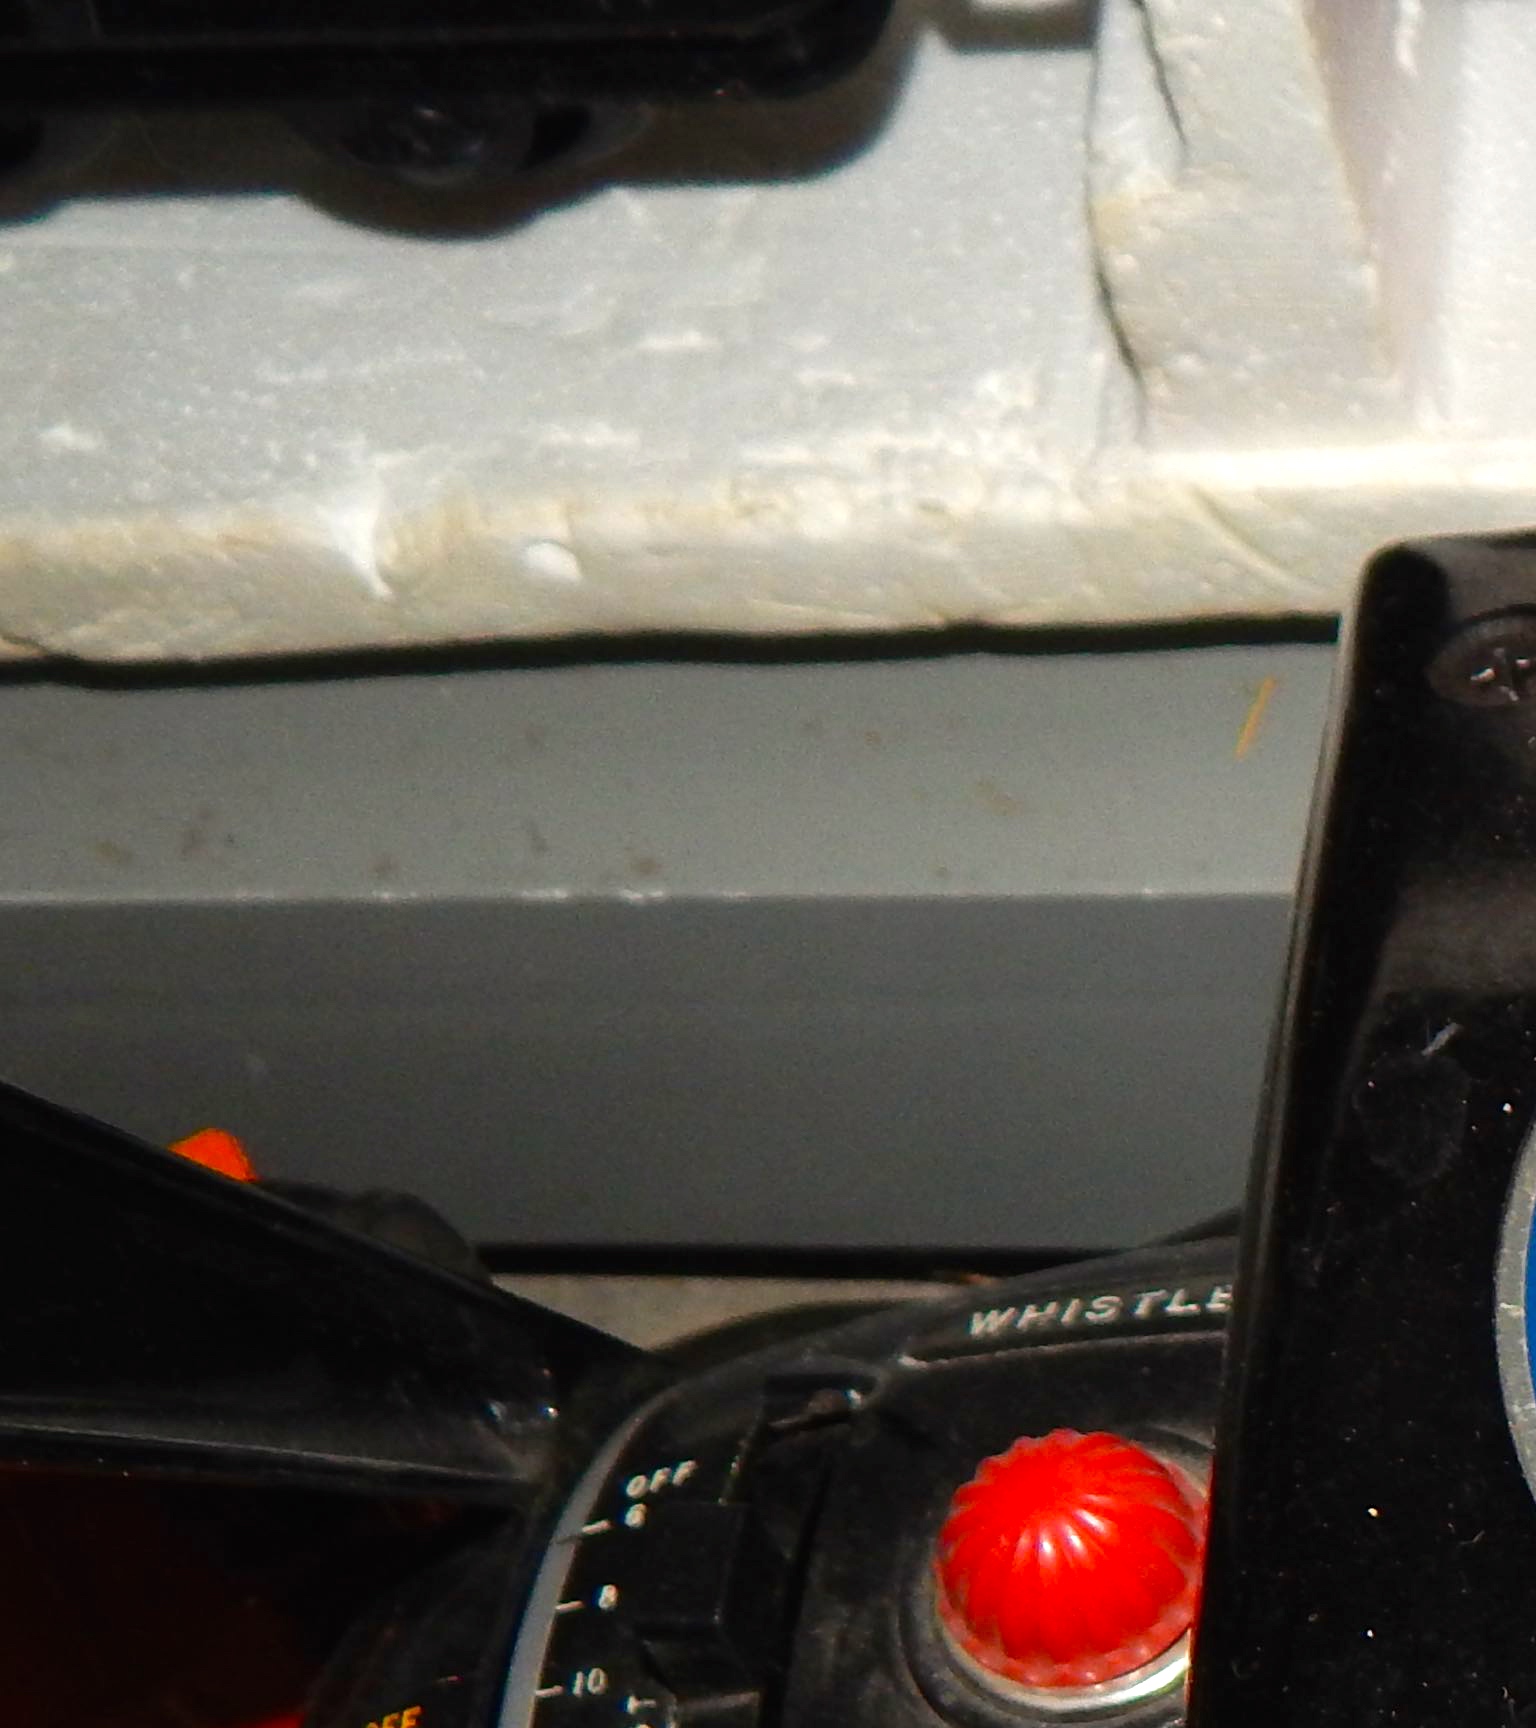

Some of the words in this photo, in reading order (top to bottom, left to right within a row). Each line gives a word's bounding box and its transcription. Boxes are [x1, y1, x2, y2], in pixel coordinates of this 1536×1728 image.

[969, 1284, 1233, 1336] WHISTLE
[626, 1459, 698, 1499] OFF
[598, 1583, 620, 1612] 8
[572, 1667, 609, 1696] 10
